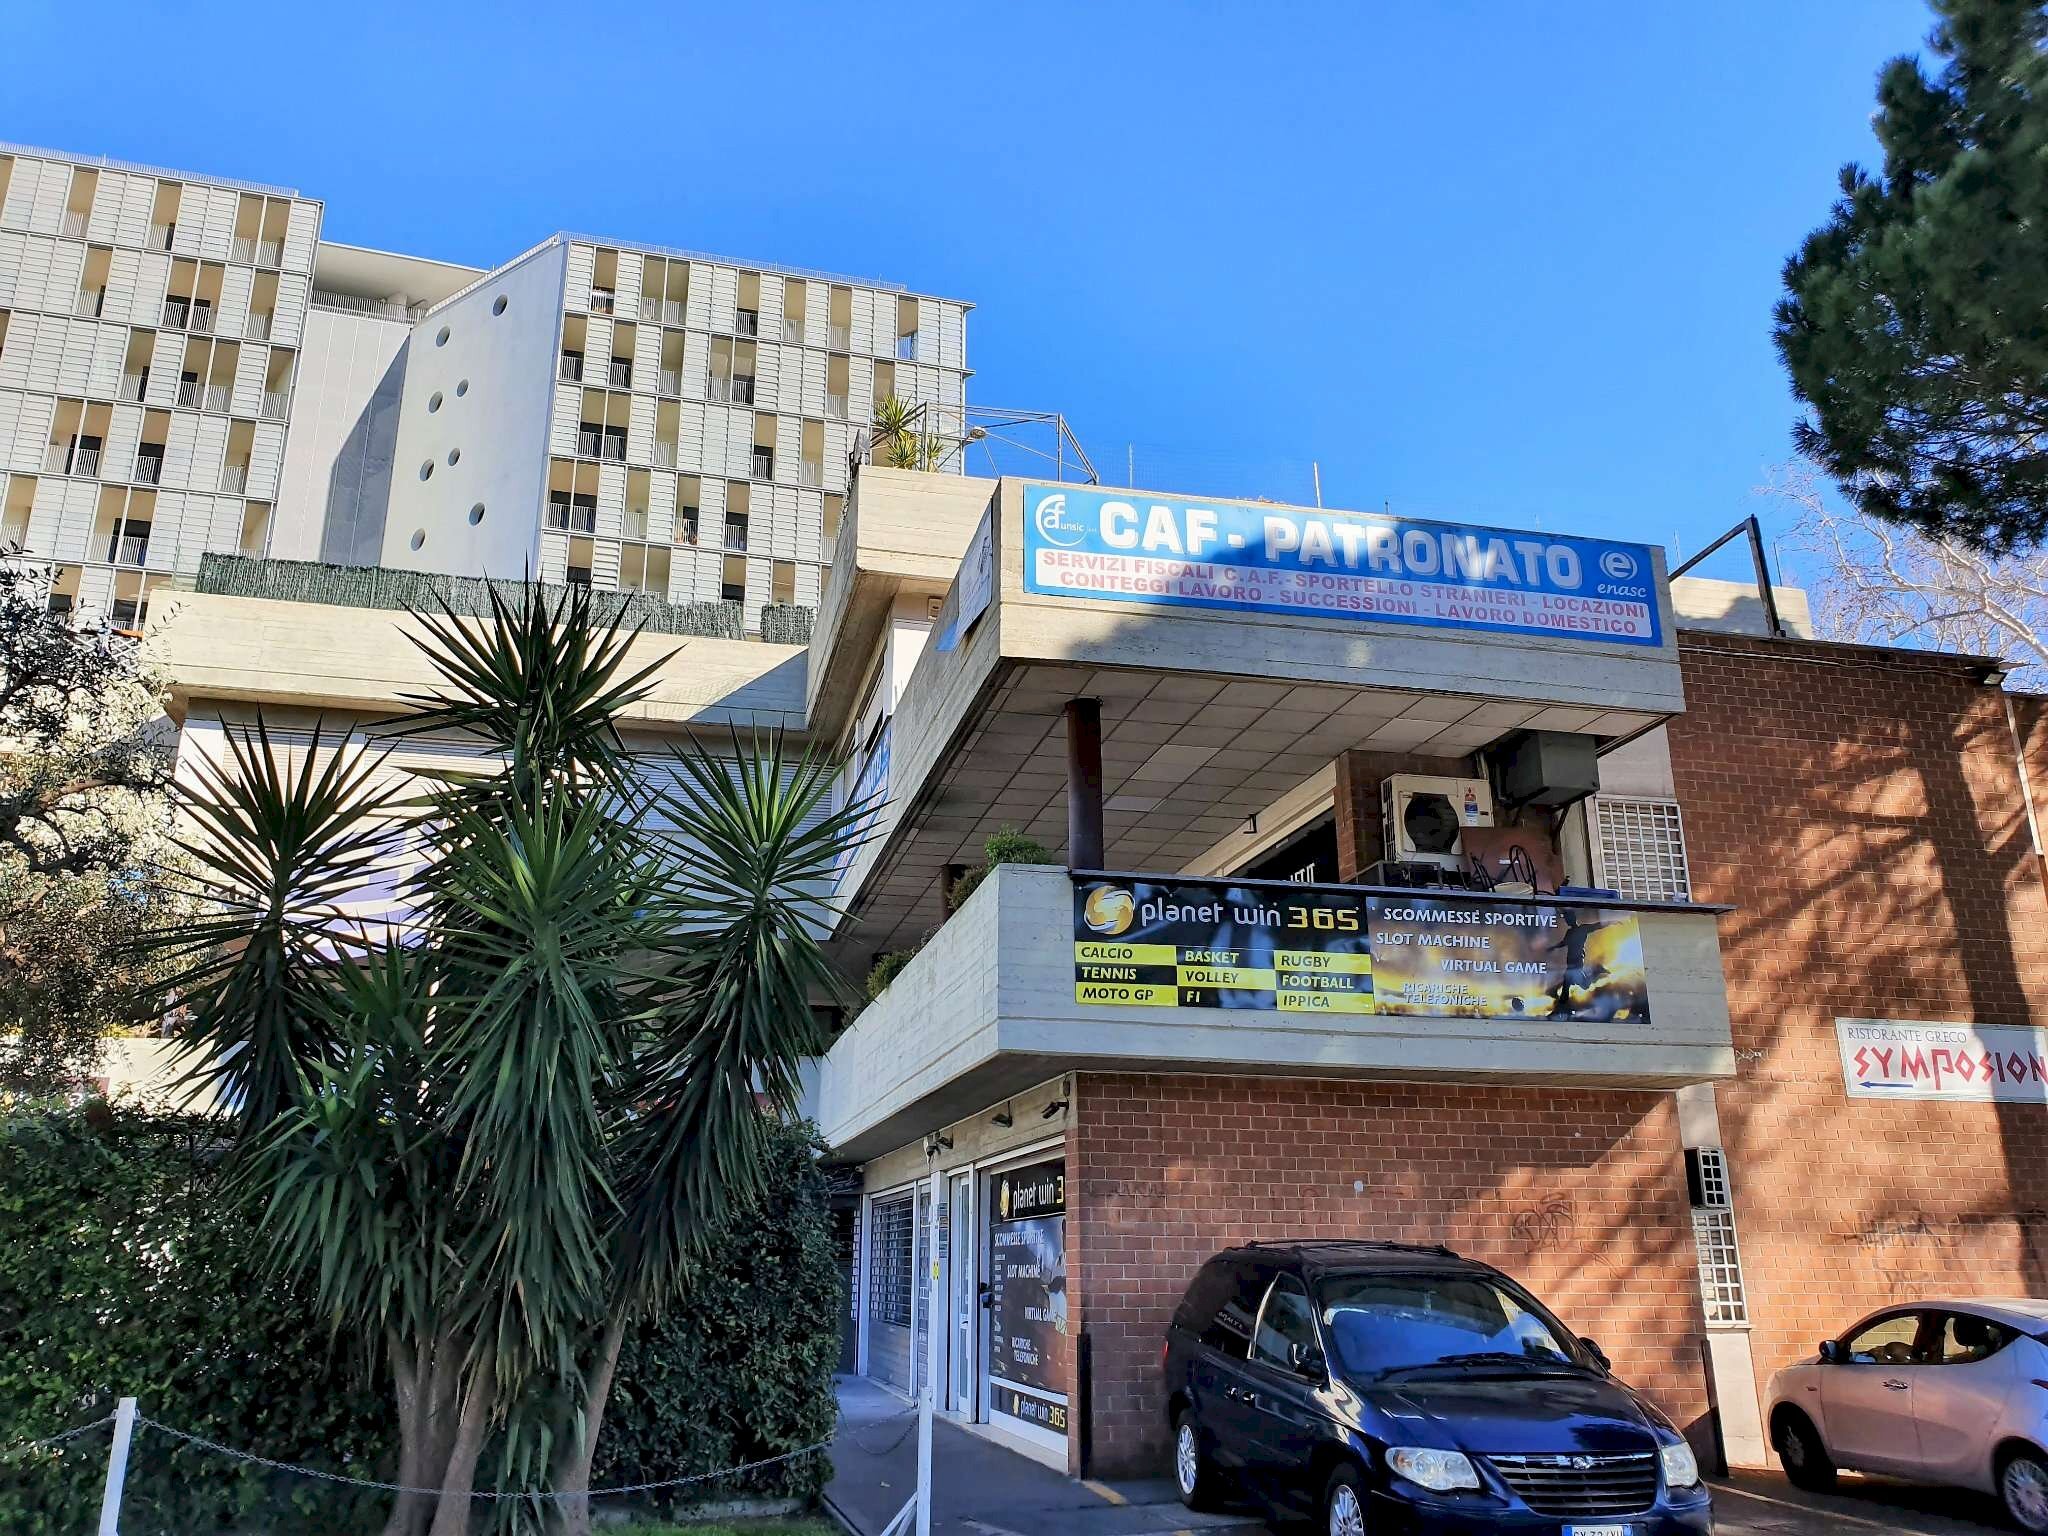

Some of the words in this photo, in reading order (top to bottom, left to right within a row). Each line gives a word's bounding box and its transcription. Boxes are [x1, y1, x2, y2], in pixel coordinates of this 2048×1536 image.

[1099, 501, 1219, 557] CAF
[1263, 516, 1583, 590] PATRONATO
[1043, 551, 1127, 572] SERVIZI
[1134, 559, 1214, 580] FISCALI
[1295, 573, 1413, 596] SPORTELLO
[1420, 584, 1526, 606] STRANIERI
[1543, 595, 1645, 618] LOCAZIONI
[1597, 583, 1648, 598] enasc
[1060, 571, 1170, 594] CONTEGGI
[1179, 581, 1262, 601] LAVORO
[1280, 590, 1417, 614] SUCCESSIONI
[1435, 602, 1516, 624] LAVORO
[1522, 610, 1637, 634] DOMESTICO
[1141, 897, 1223, 928] planet
[1234, 902, 1281, 926] win
[1287, 906, 1360, 931] 365
[1383, 907, 1481, 924] SCOMMESSE
[1485, 912, 1558, 928] SPORTIVE
[1376, 932, 1413, 945] SLOT
[1417, 934, 1490, 949] MACHINE
[1081, 946, 1133, 960] CALCIO
[1184, 951, 1240, 965] BASKET
[1281, 955, 1331, 968] RUGBY
[1440, 959, 1501, 973] VIRTUAL
[1505, 961, 1547, 975] GAME
[1081, 966, 1137, 981] TENNIS
[1185, 970, 1239, 985] VOLLEY
[1281, 974, 1354, 990] FOOTBALL
[1402, 982, 1468, 995] RICARICHE
[1082, 987, 1130, 1000] MOTO
[1135, 988, 1154, 1001] GP
[1283, 995, 1331, 1008] IPPICA
[1403, 993, 1488, 1007] TELEFONICHE
[1847, 1027, 1922, 1043] RISTORANTE
[1925, 1031, 1967, 1044] GRECO
[1853, 1045, 2048, 1091] SYMPOSION
[1013, 1180, 1036, 1217] planet
[1038, 1177, 1055, 1206] win
[1020, 1395, 1037, 1418] planet
[1037, 1400, 1049, 1422] win
[1048, 1405, 1066, 1428] 365
